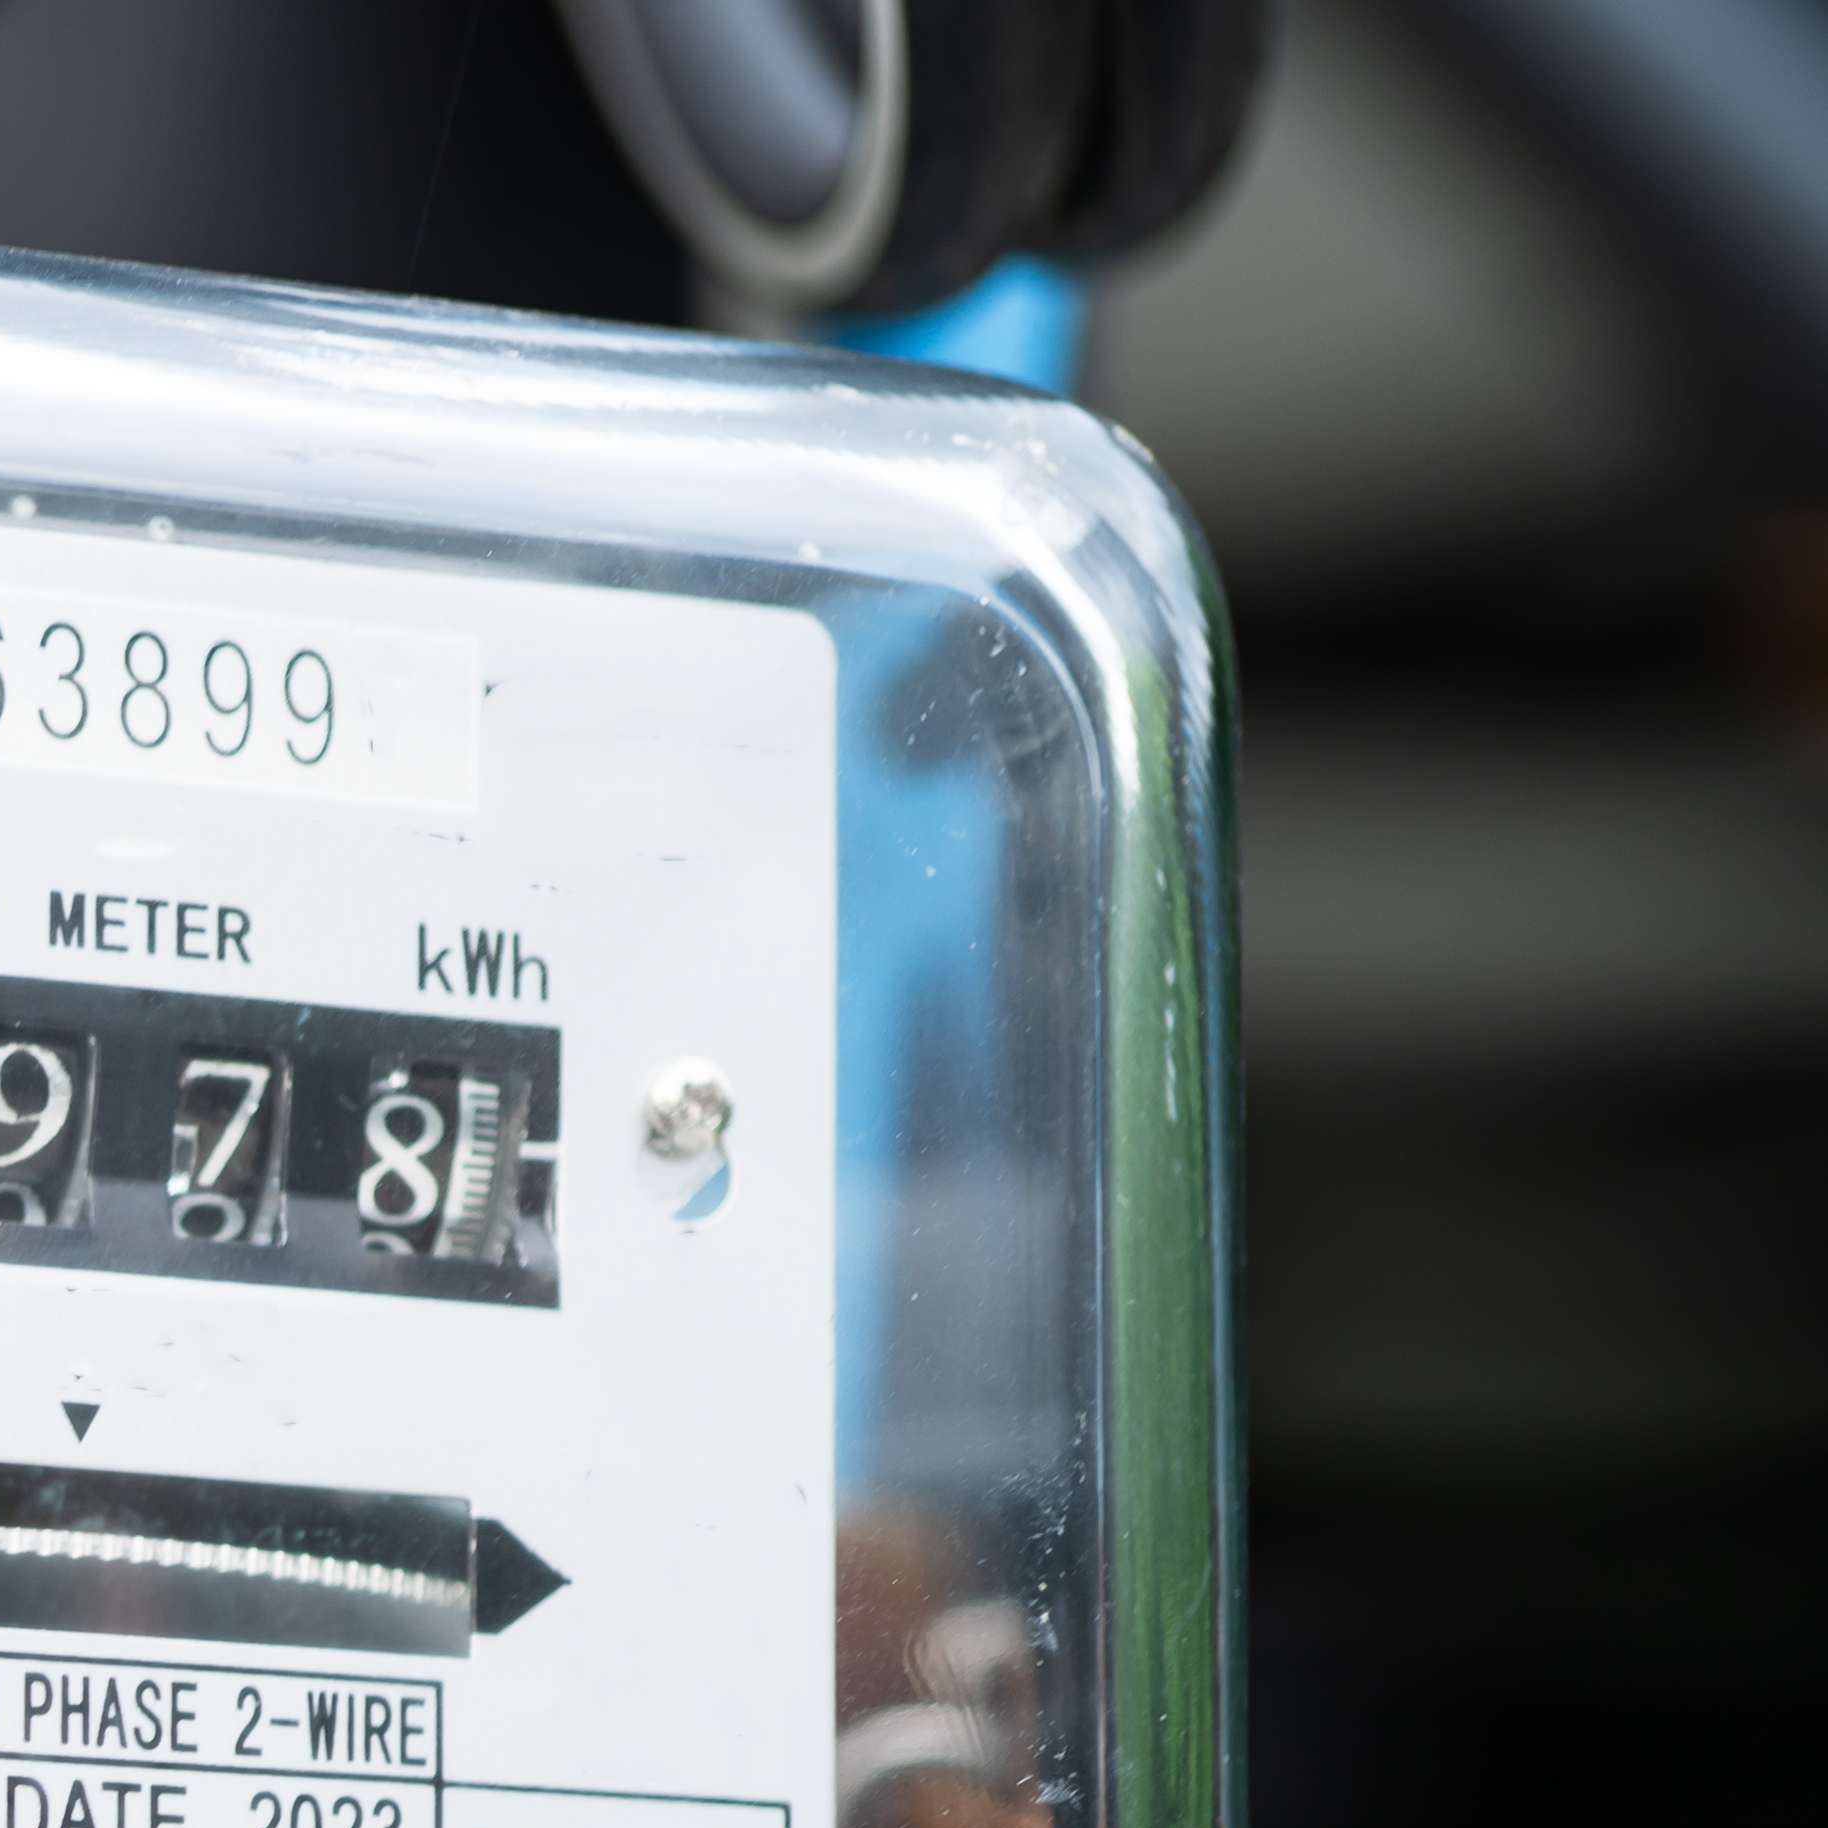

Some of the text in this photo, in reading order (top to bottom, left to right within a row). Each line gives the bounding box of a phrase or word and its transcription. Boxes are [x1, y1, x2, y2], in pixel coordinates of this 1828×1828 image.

[48, 890, 253, 964] METER
[416, 922, 550, 1002] kWh
[23, 1671, 199, 1754] PHASE
[234, 1685, 428, 1767] 2-WIRE
